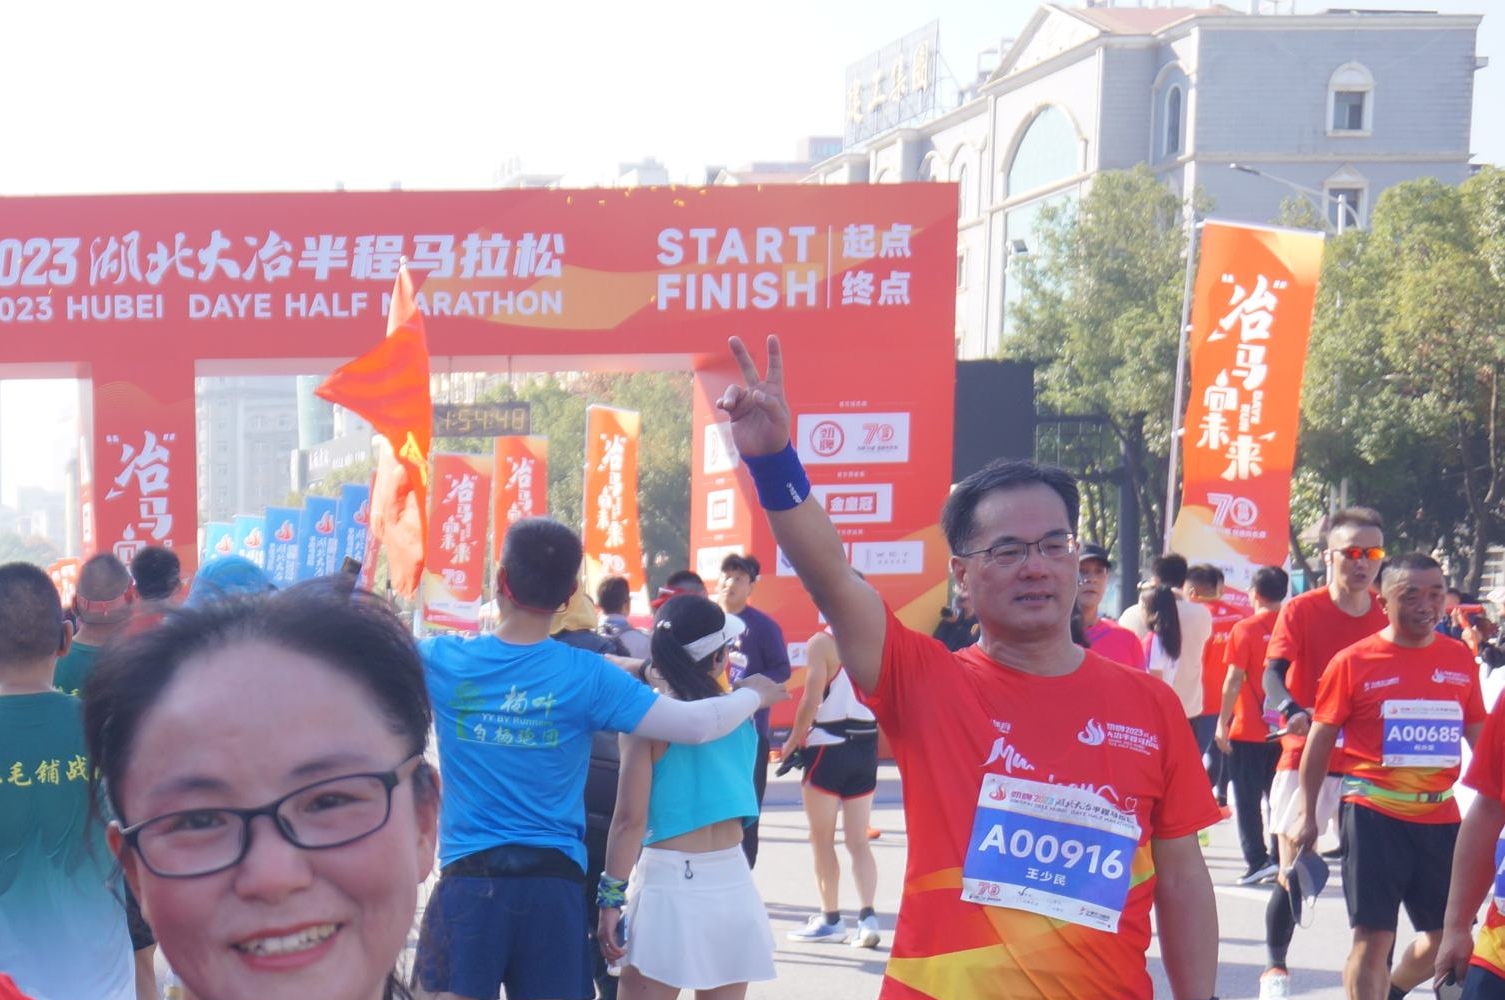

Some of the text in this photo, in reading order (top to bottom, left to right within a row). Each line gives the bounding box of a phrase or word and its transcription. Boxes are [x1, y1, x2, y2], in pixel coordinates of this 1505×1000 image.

[90, 229, 565, 285] 湖北大冶半程马拉松
[657, 226, 816, 265] START
[842, 223, 912, 259] 起点
[67, 294, 163, 320] HUBEI
[189, 293, 271, 318] DAYE
[285, 292, 367, 317] HALF
[657, 270, 817, 311] FINISH
[842, 270, 912, 307] 终点
[1387, 726, 1460, 743] A00685
[978, 824, 1124, 879] A00916
[1025, 867, 1068, 886] 王少民
